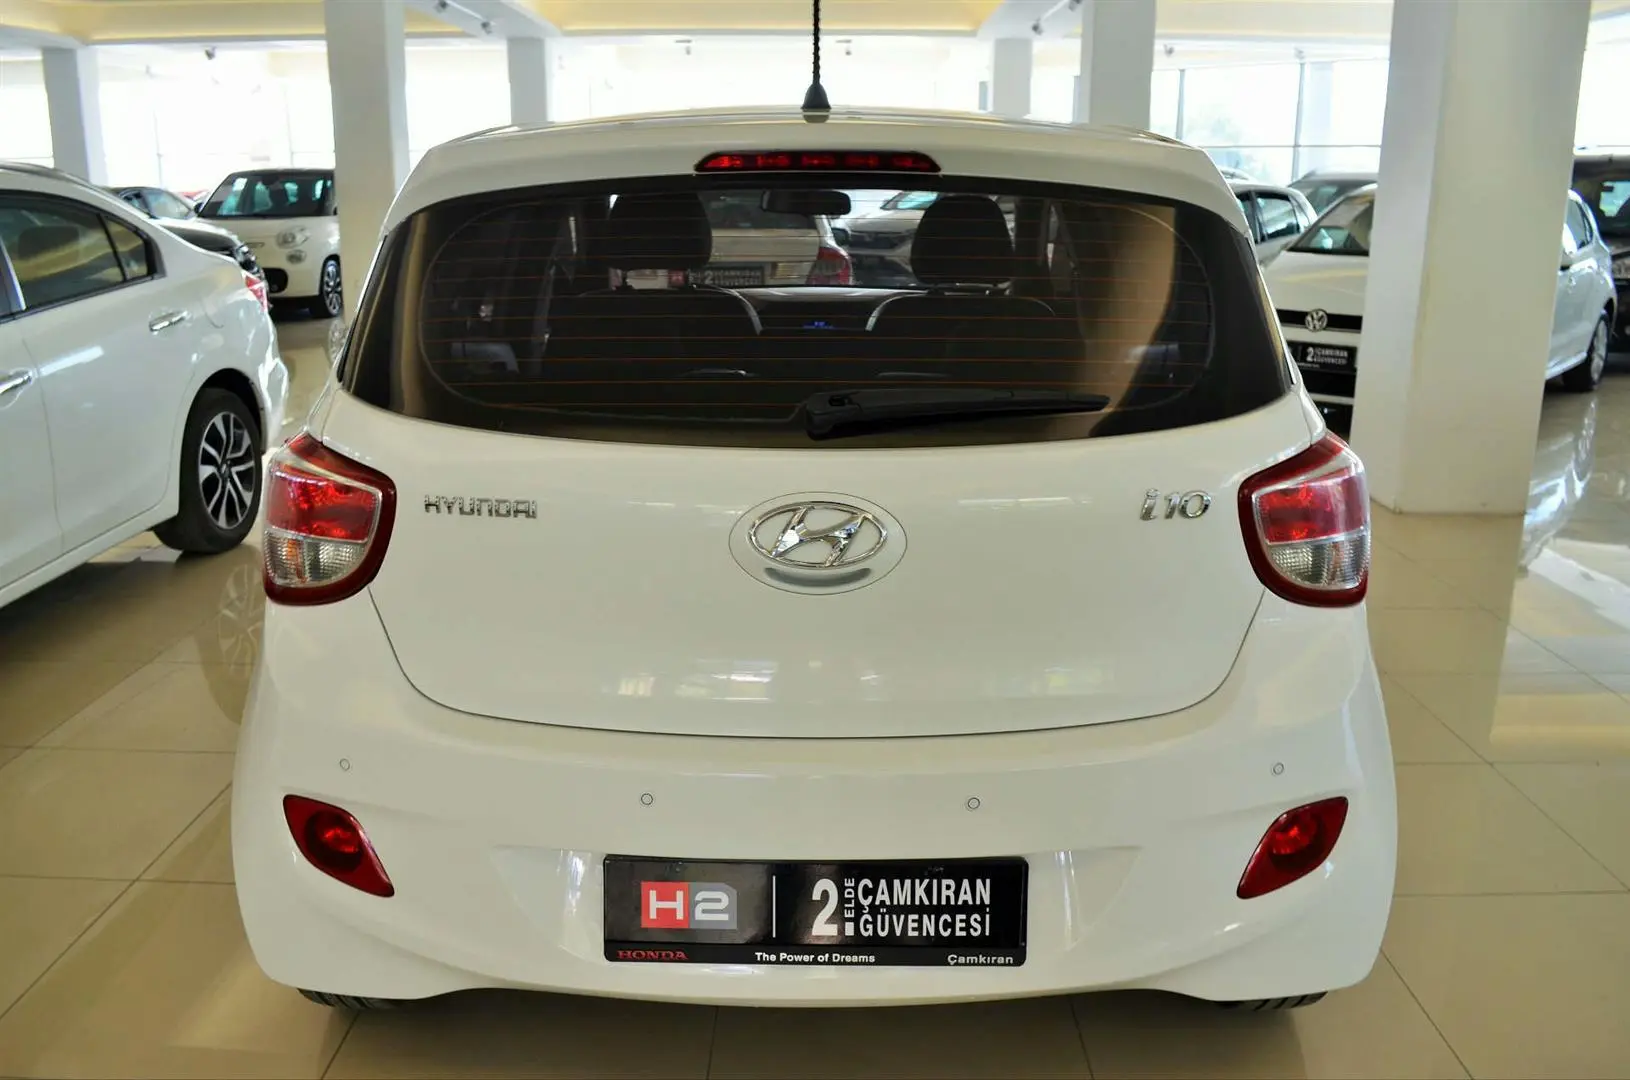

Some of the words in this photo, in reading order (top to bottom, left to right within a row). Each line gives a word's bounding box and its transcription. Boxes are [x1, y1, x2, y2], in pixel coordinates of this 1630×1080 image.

[424, 494, 537, 519] HYUNDAI
[1140, 488, 1211, 521] i10
[649, 889, 730, 921] H2
[844, 877, 855, 918] ELDE
[857, 878, 991, 913] ÇAMKIRAN
[859, 907, 990, 937] GÜVENCESİ
[617, 950, 688, 960] HONDA
[755, 952, 777, 962] The
[779, 952, 815, 963] Power
[817, 952, 830, 963] of
[832, 953, 876, 963] Dreams
[947, 953, 1014, 966] Çamkıran
